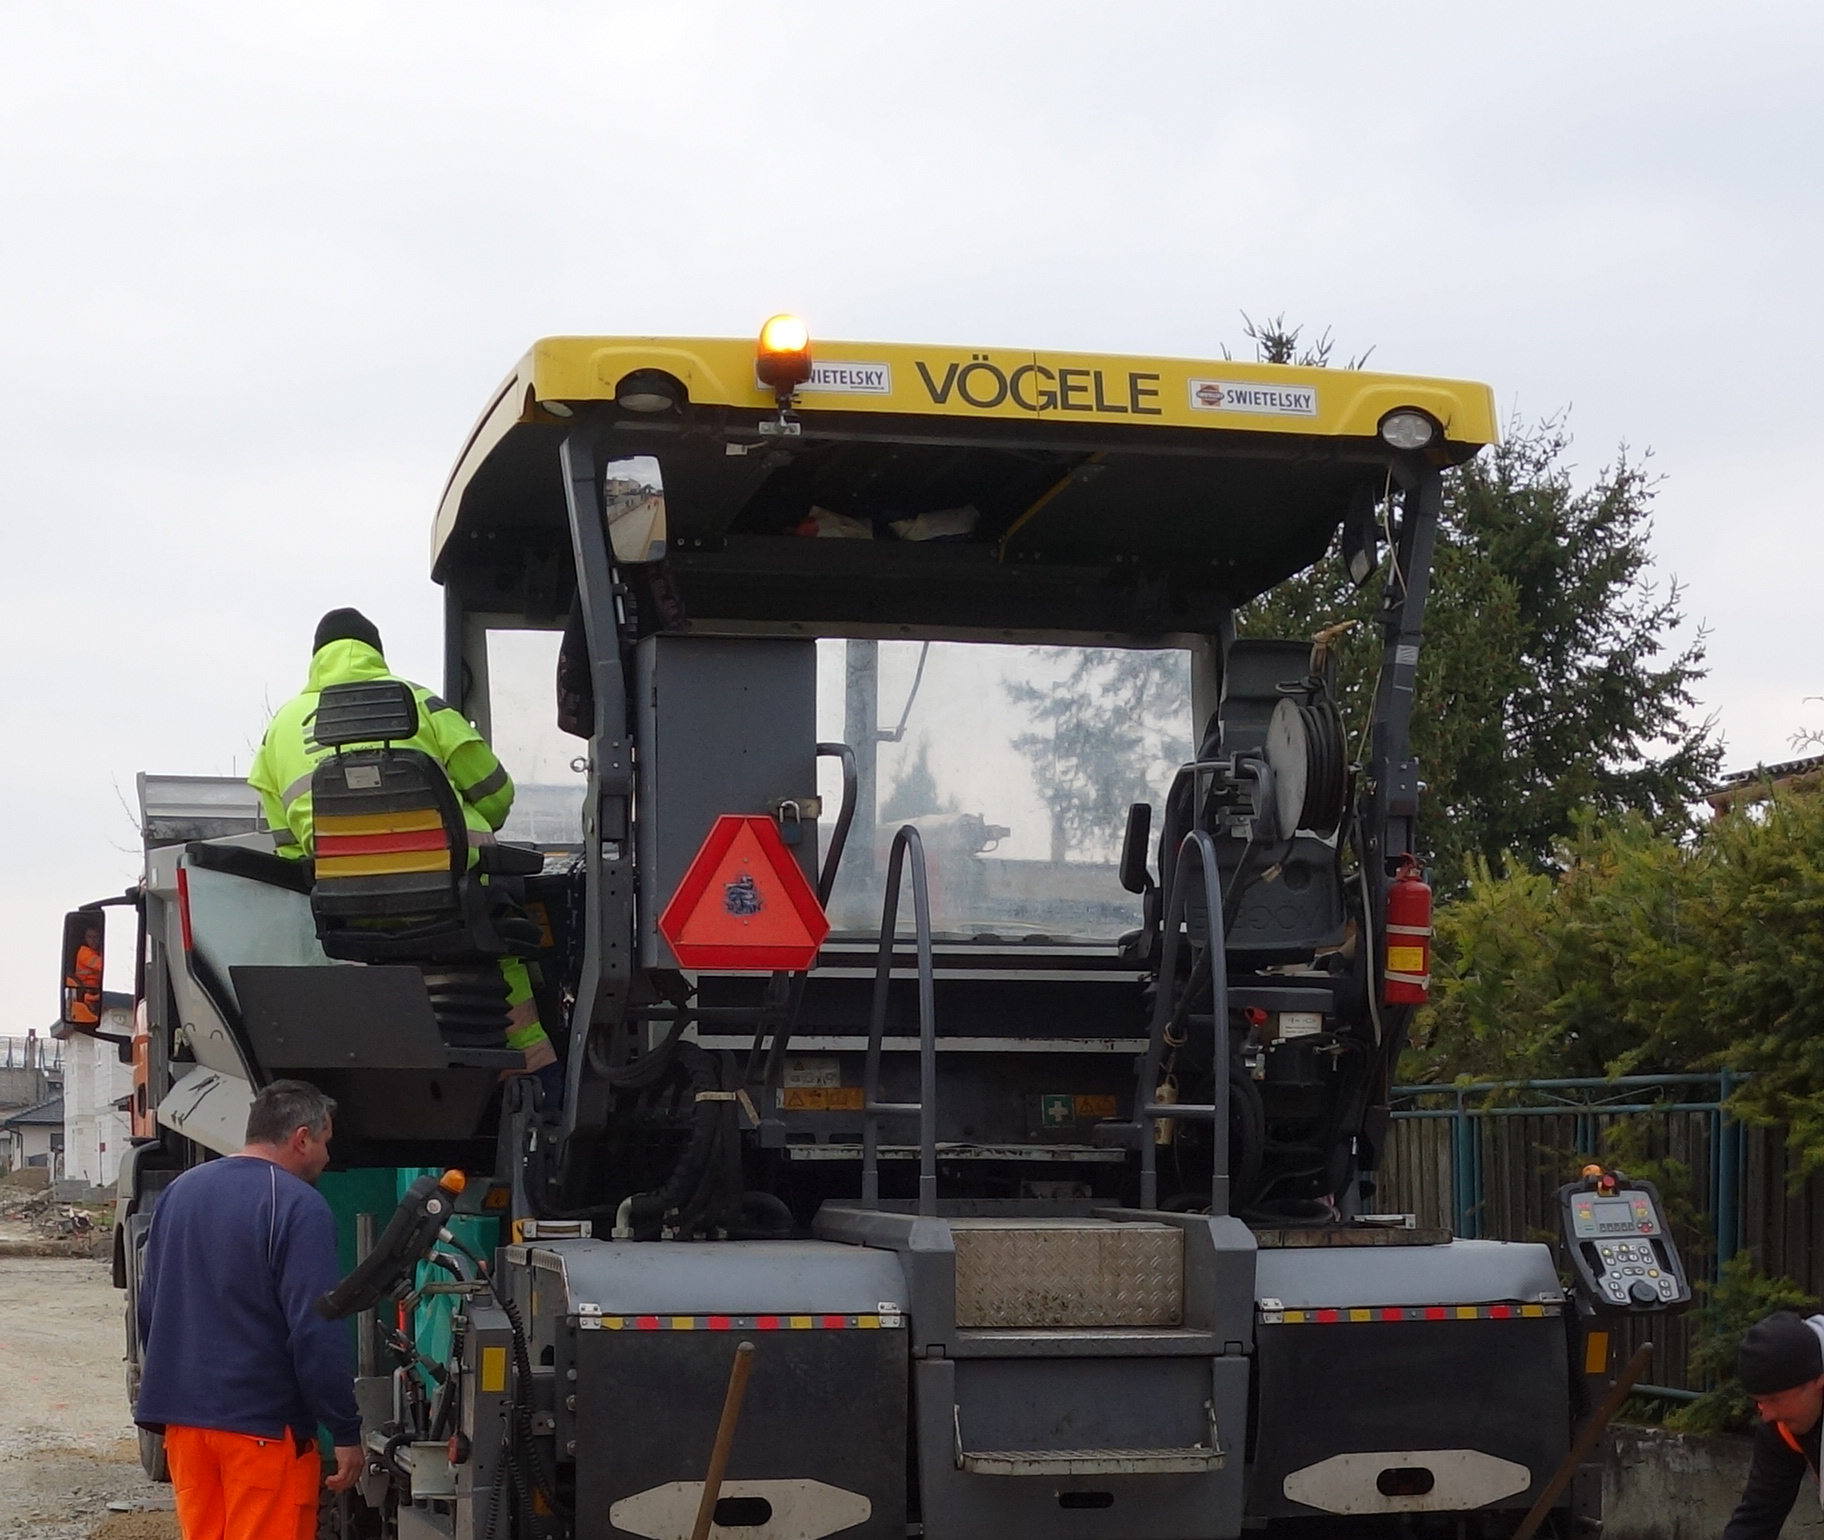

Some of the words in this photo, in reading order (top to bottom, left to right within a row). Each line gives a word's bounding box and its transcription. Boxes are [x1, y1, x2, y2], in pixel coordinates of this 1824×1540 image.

[809, 369, 883, 386] IETELSKY
[915, 353, 1162, 416] VÖGELE
[1227, 389, 1311, 409] SWIETELSKY
